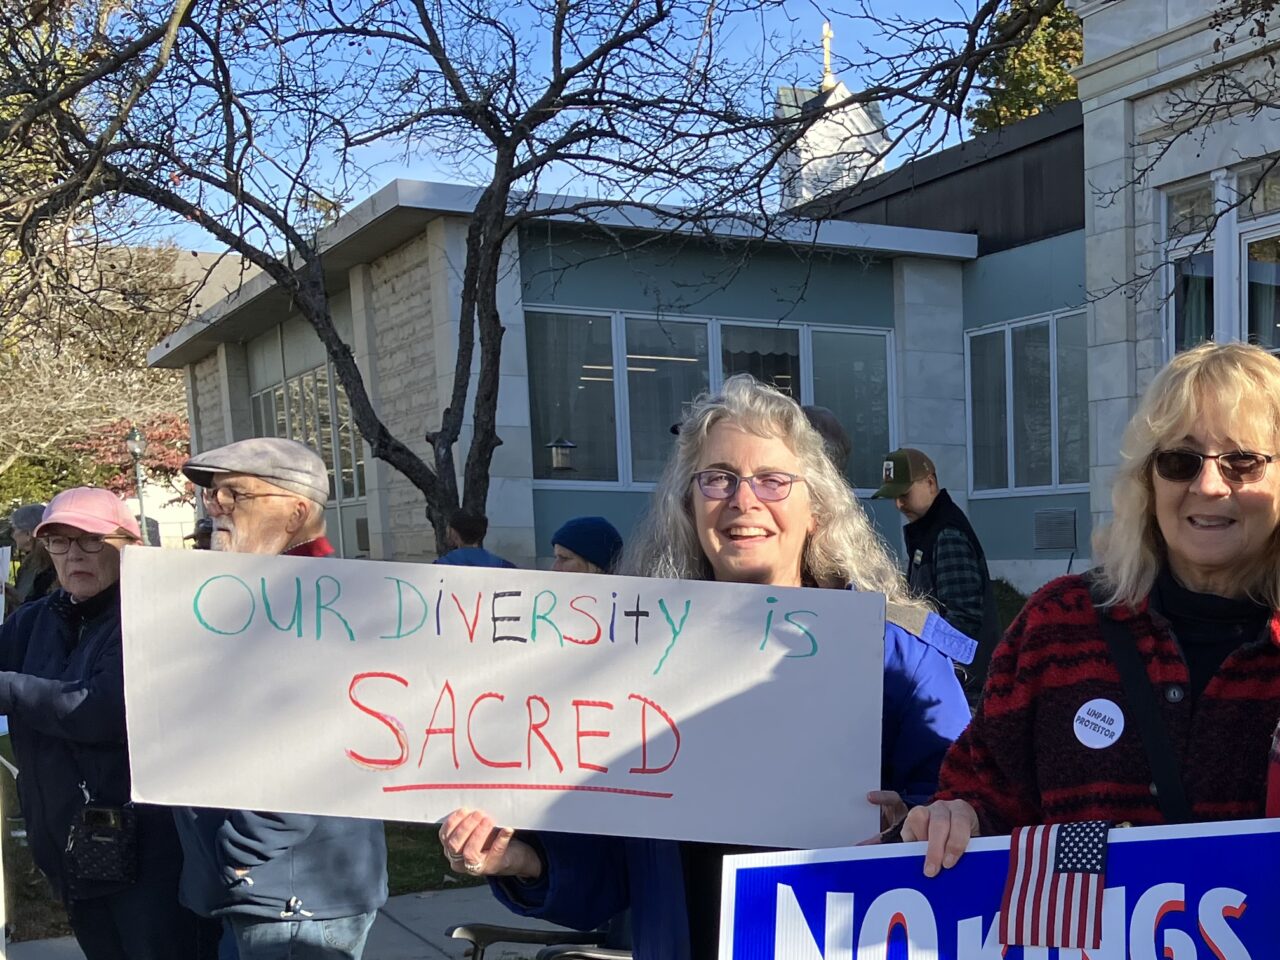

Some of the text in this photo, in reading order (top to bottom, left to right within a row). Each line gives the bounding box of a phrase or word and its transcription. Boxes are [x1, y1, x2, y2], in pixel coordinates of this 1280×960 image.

[193, 574, 355, 641] OUR
[344, 672, 681, 775] SACRED
[1075, 715, 1116, 740] PROTESTOR
[1086, 708, 1115, 726] UNPAID
